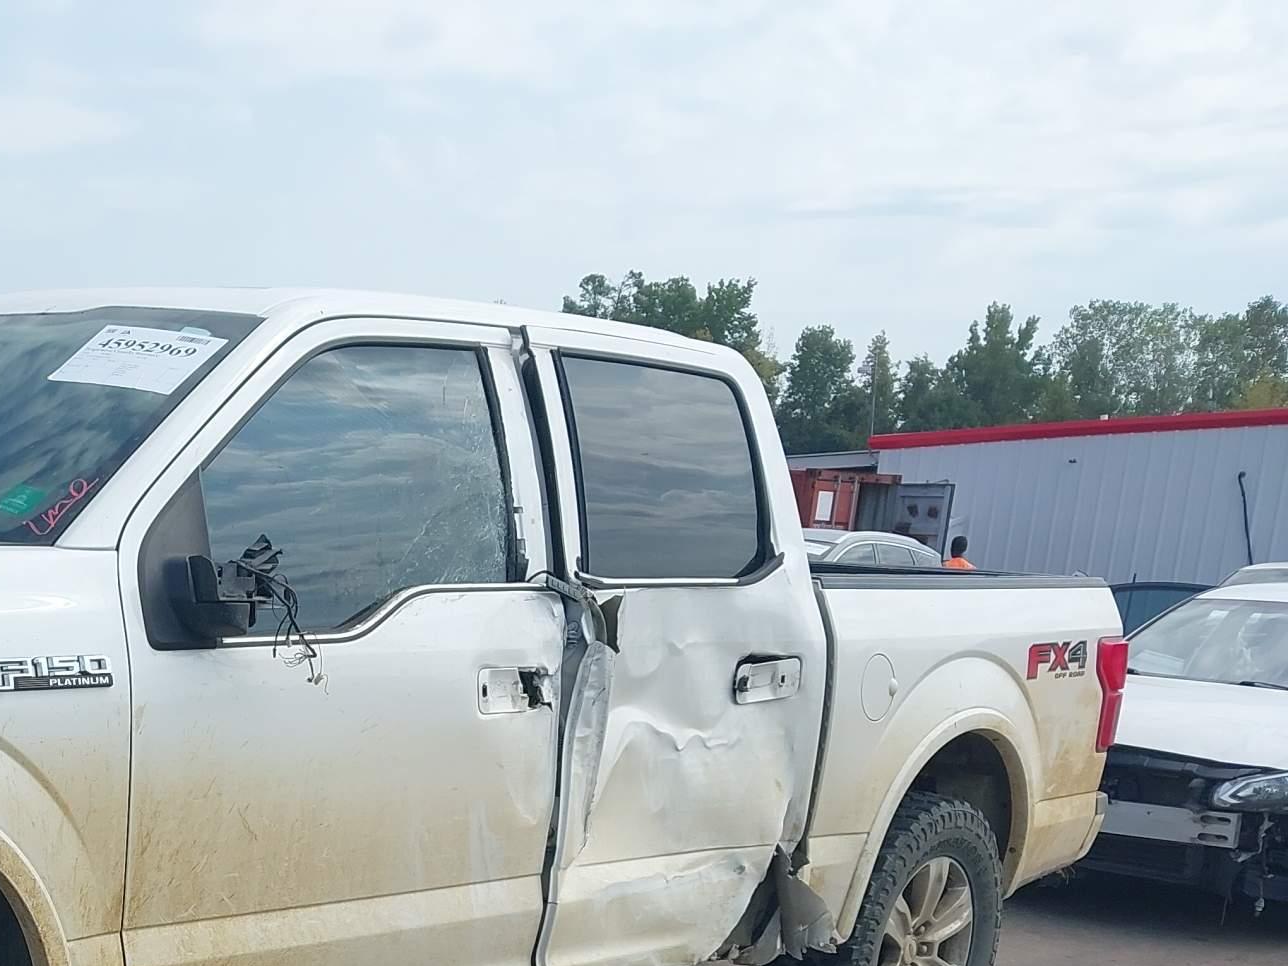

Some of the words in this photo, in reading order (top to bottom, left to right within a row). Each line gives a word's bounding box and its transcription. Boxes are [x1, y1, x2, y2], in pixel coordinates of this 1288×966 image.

[98, 338, 198, 358] 45952969
[1026, 640, 1088, 680] FX4
[49, 676, 110, 687] PLATINUM
[1069, 670, 1085, 678] ROAD
